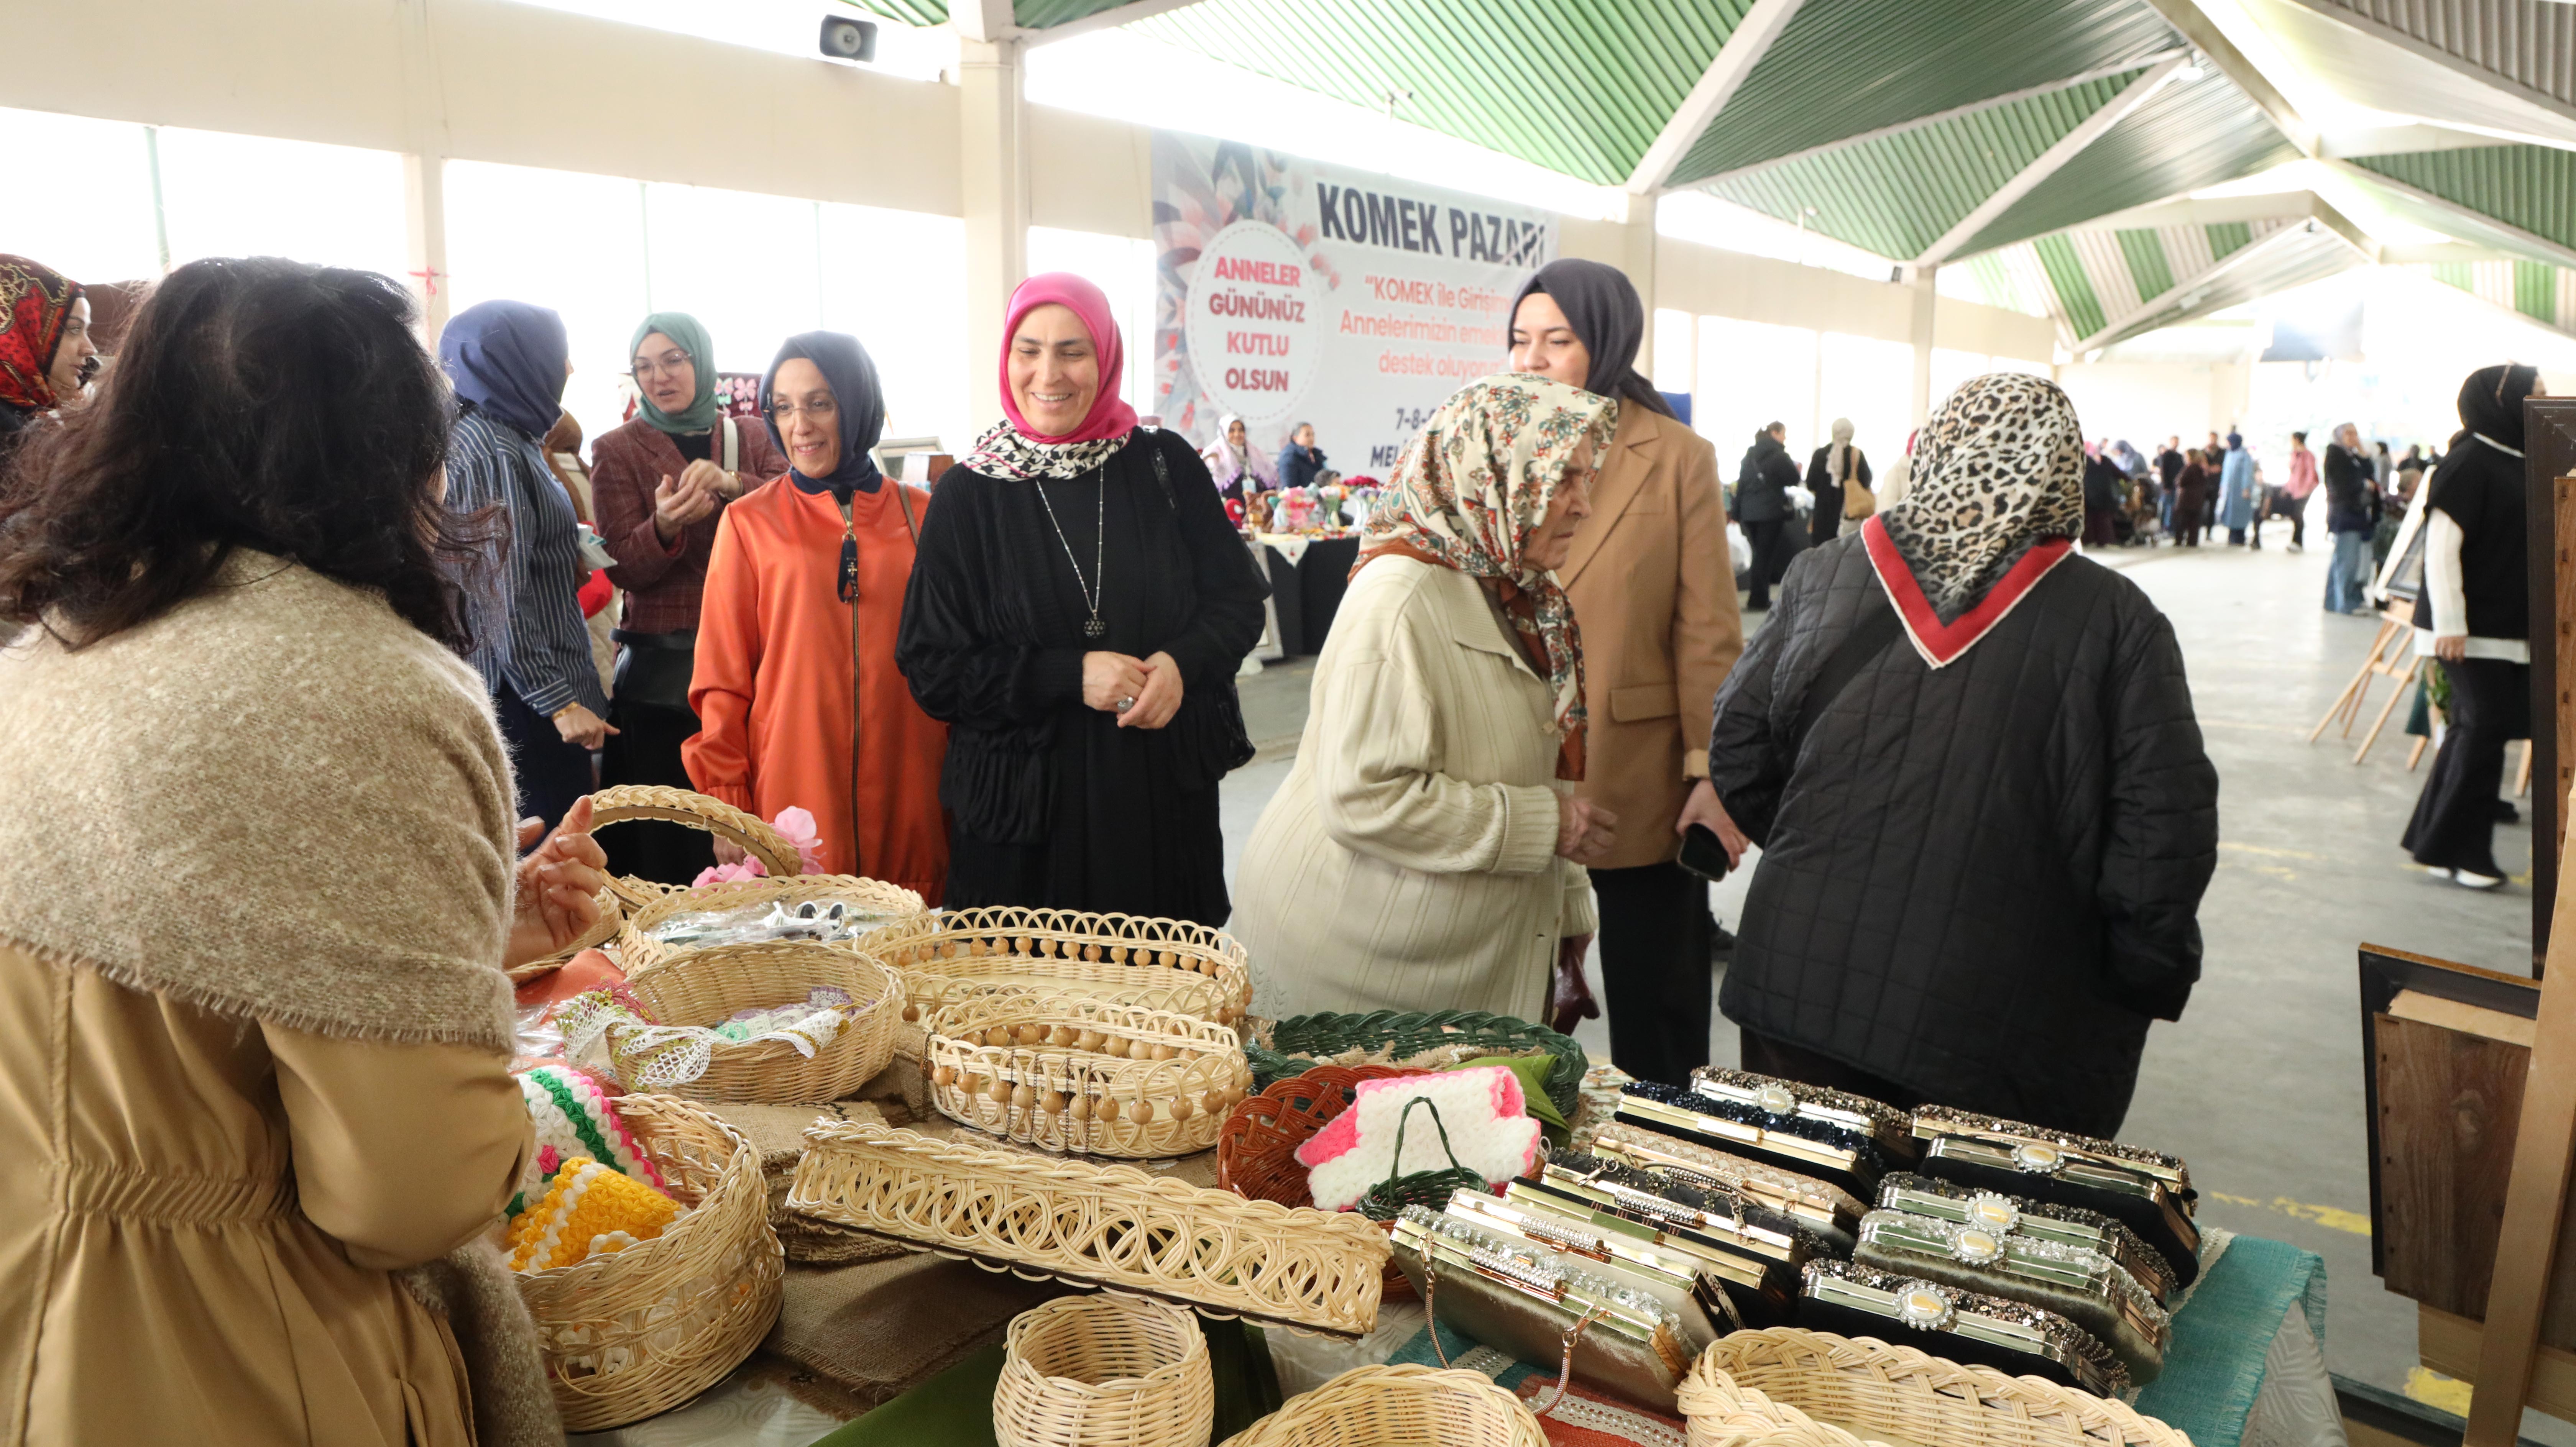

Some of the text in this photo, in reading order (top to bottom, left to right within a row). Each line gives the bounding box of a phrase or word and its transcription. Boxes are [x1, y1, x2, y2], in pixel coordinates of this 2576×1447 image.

[1316, 182, 1442, 256] KOMEK
[1214, 256, 1301, 287] ANNELER
[1209, 288, 1305, 323] GÜNÜNÜZ
[1437, 282, 1455, 308] ile
[1340, 309, 1457, 342] Annelerimizin
[1227, 331, 1290, 356] KUTLU
[1379, 349, 1433, 376] destek
[1225, 367, 1289, 392] OLSUN
